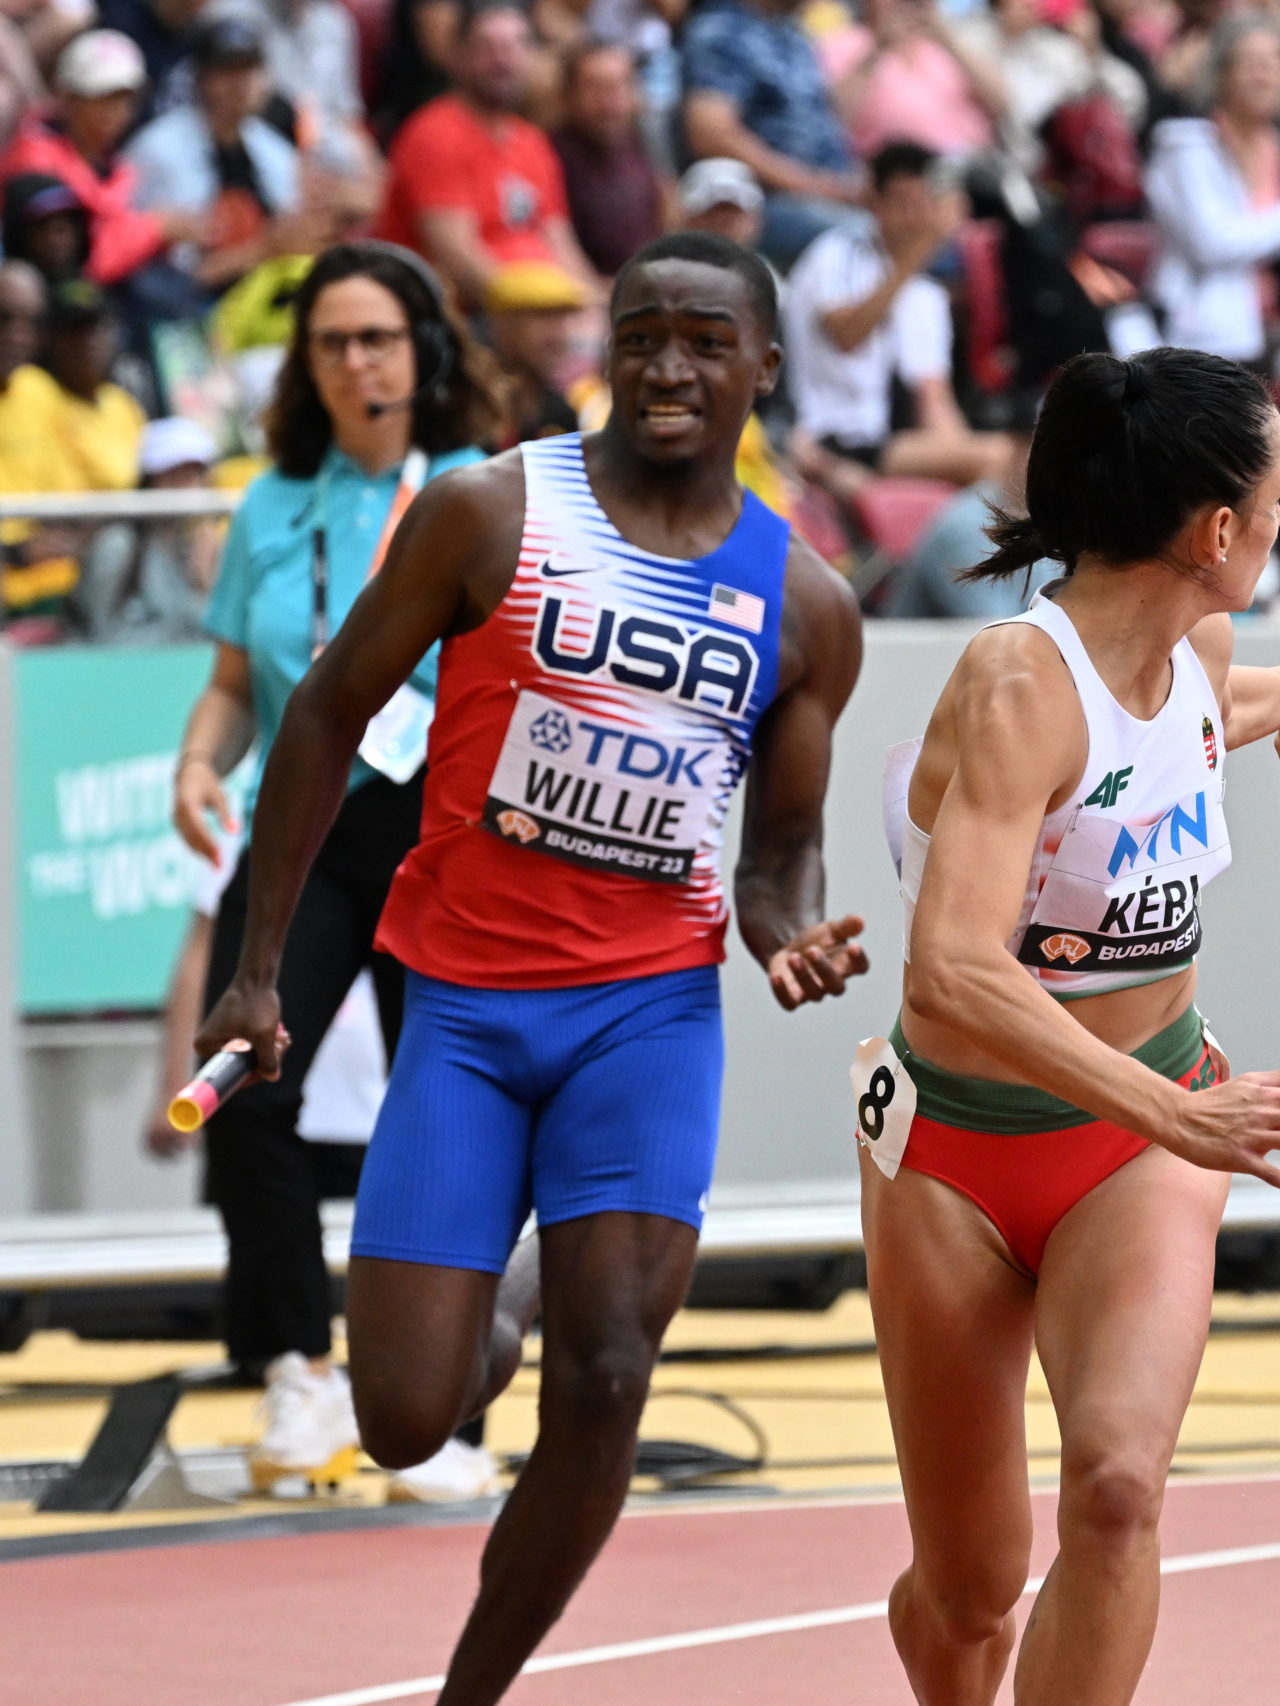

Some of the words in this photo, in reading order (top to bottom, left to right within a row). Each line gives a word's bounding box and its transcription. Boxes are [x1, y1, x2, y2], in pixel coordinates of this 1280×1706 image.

[535, 597, 754, 714] USA
[577, 721, 713, 788] TDK
[1084, 765, 1134, 809] 4F
[524, 760, 686, 842] WILLIE
[544, 829, 663, 871] BUDAPEST
[662, 857, 685, 874] 23
[859, 1065, 895, 1141] 8
